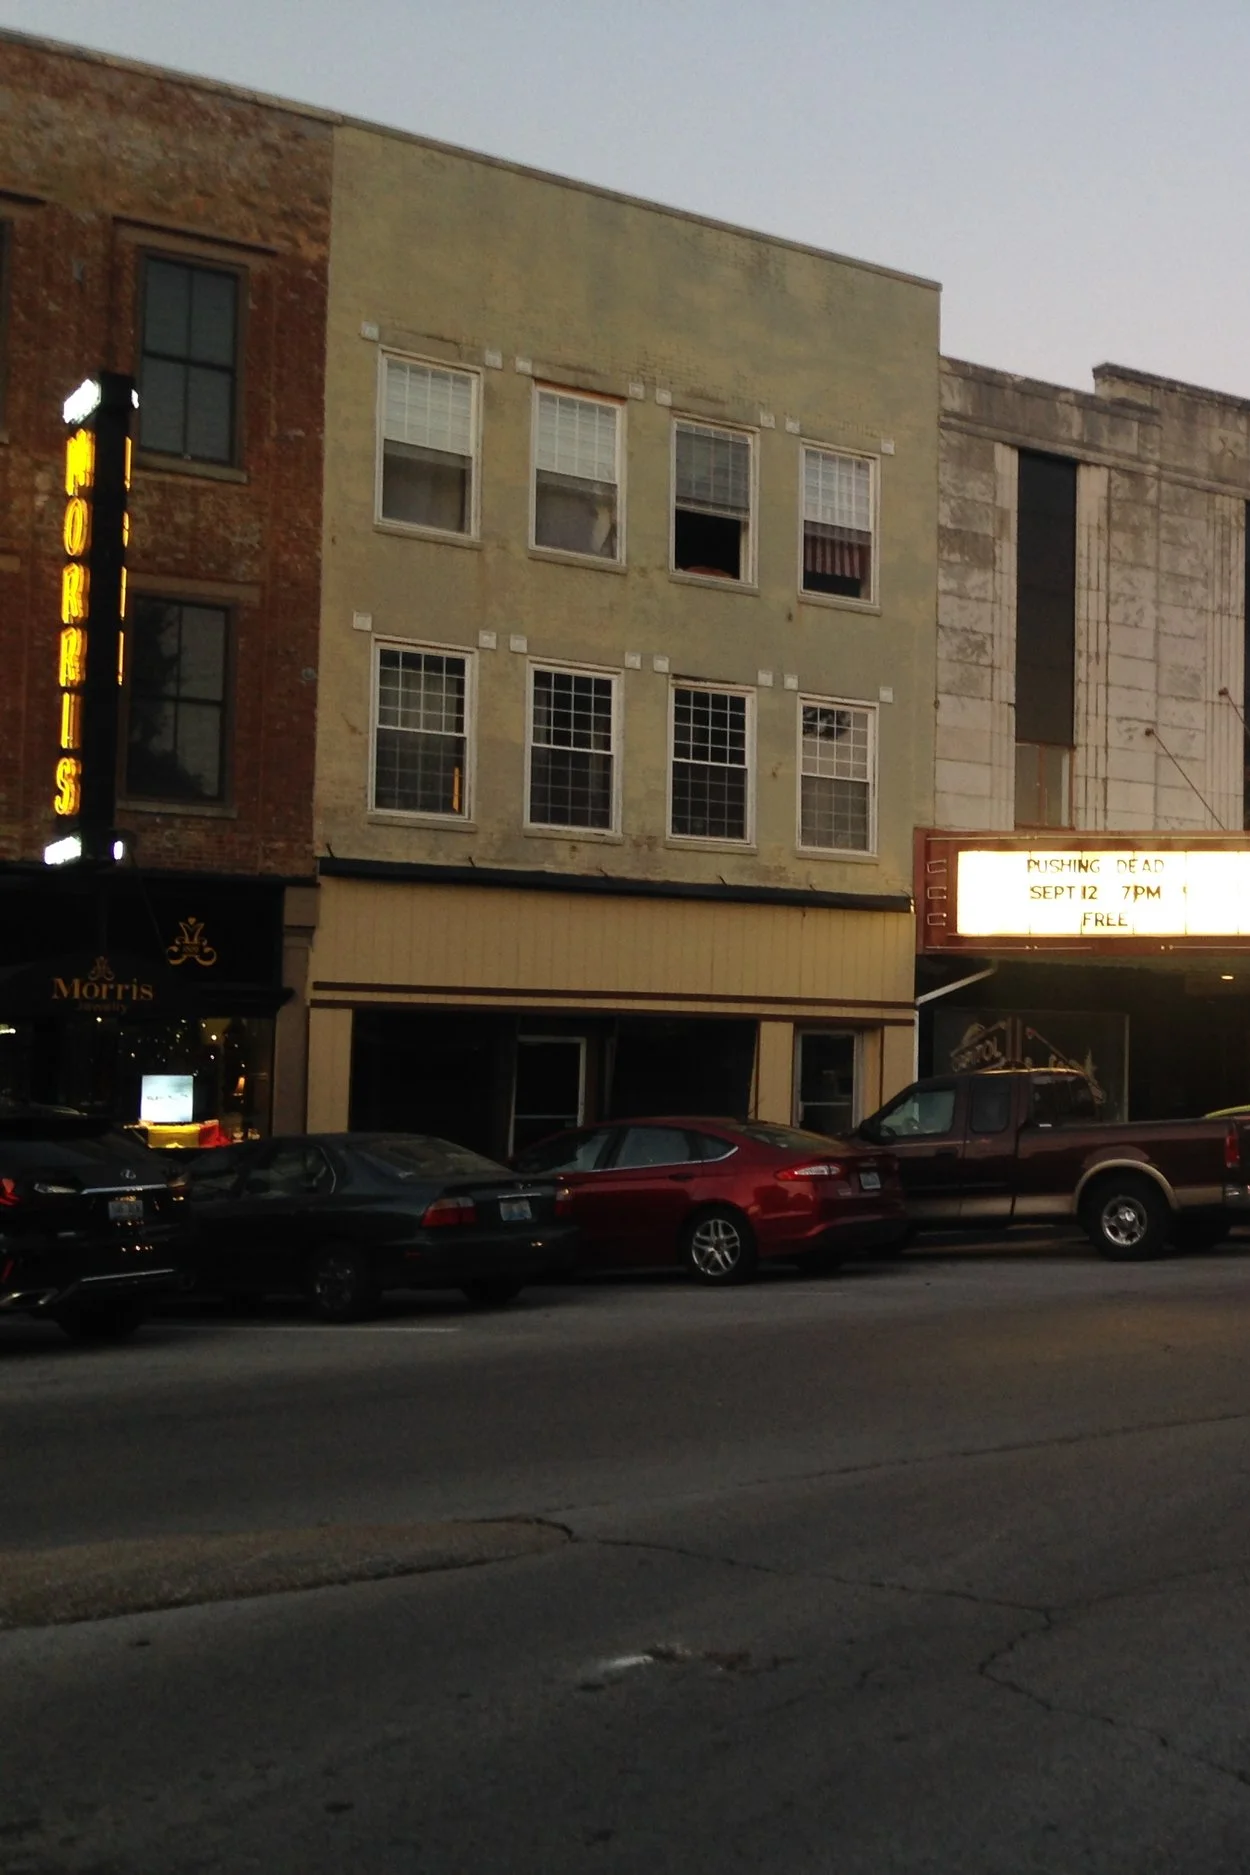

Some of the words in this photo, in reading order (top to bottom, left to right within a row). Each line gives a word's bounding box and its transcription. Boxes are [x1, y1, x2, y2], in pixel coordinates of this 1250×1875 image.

[55, 428, 96, 816] MORRIS
[1027, 858, 1100, 873] PUSHING
[1117, 858, 1165, 873] DEAD
[1030, 885, 1076, 900] SEPT
[1081, 885, 1098, 900] 12
[1082, 911, 1129, 927] FREE
[51, 976, 154, 1001] Morris
